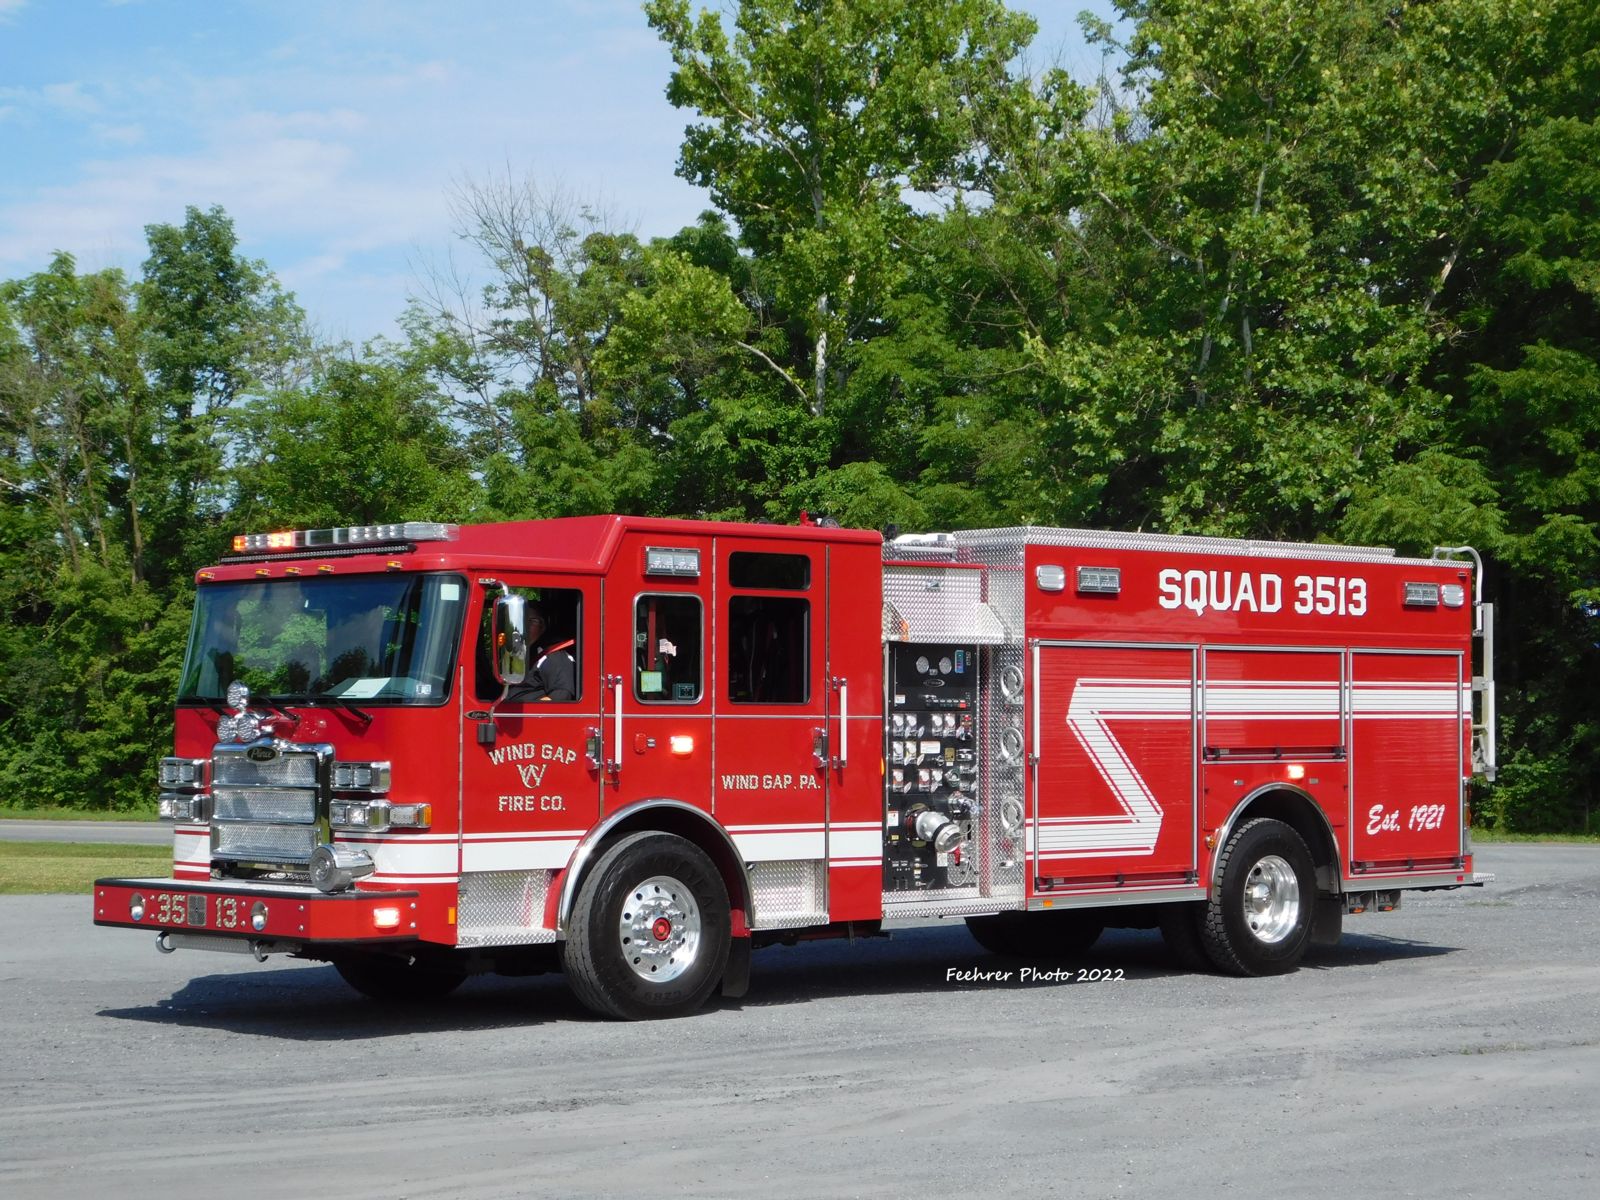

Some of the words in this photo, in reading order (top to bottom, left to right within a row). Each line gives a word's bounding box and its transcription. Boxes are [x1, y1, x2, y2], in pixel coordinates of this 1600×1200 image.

[1158, 568, 1282, 616] SQUAD
[1294, 575, 1367, 616] 3513
[488, 743, 535, 765] WIND
[541, 743, 577, 765] GAP
[721, 774, 759, 789] WIND
[799, 774, 821, 789] PA.
[498, 795, 535, 811] FIRE
[540, 795, 566, 811] CO.
[1366, 804, 1400, 835] Est.
[1408, 804, 1446, 832] 1921
[157, 893, 186, 924] 35
[215, 897, 237, 928] 13
